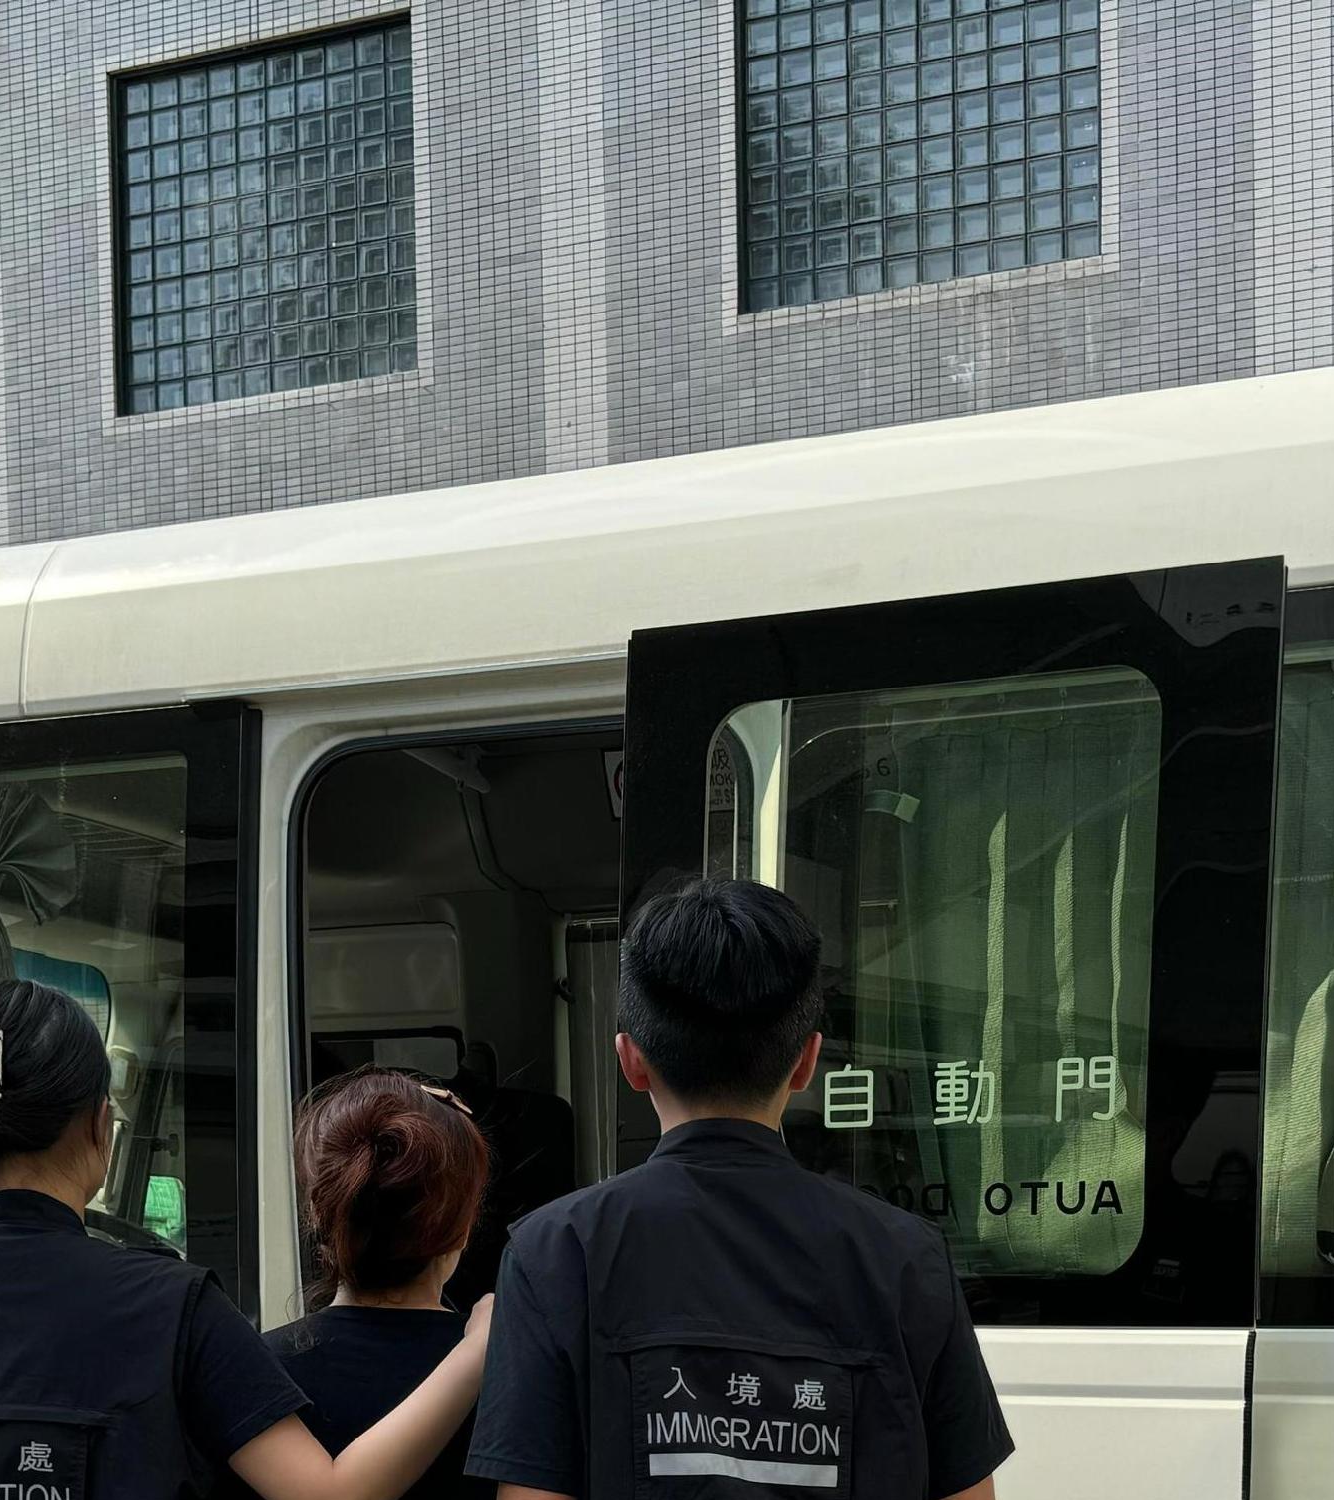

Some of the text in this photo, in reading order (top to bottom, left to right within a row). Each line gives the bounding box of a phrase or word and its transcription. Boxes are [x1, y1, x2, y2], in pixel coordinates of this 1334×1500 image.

[824, 1055, 1117, 1129] 自動門
[663, 1366, 827, 1411] 入境處
[646, 1411, 841, 1457] IMMIGRATION
